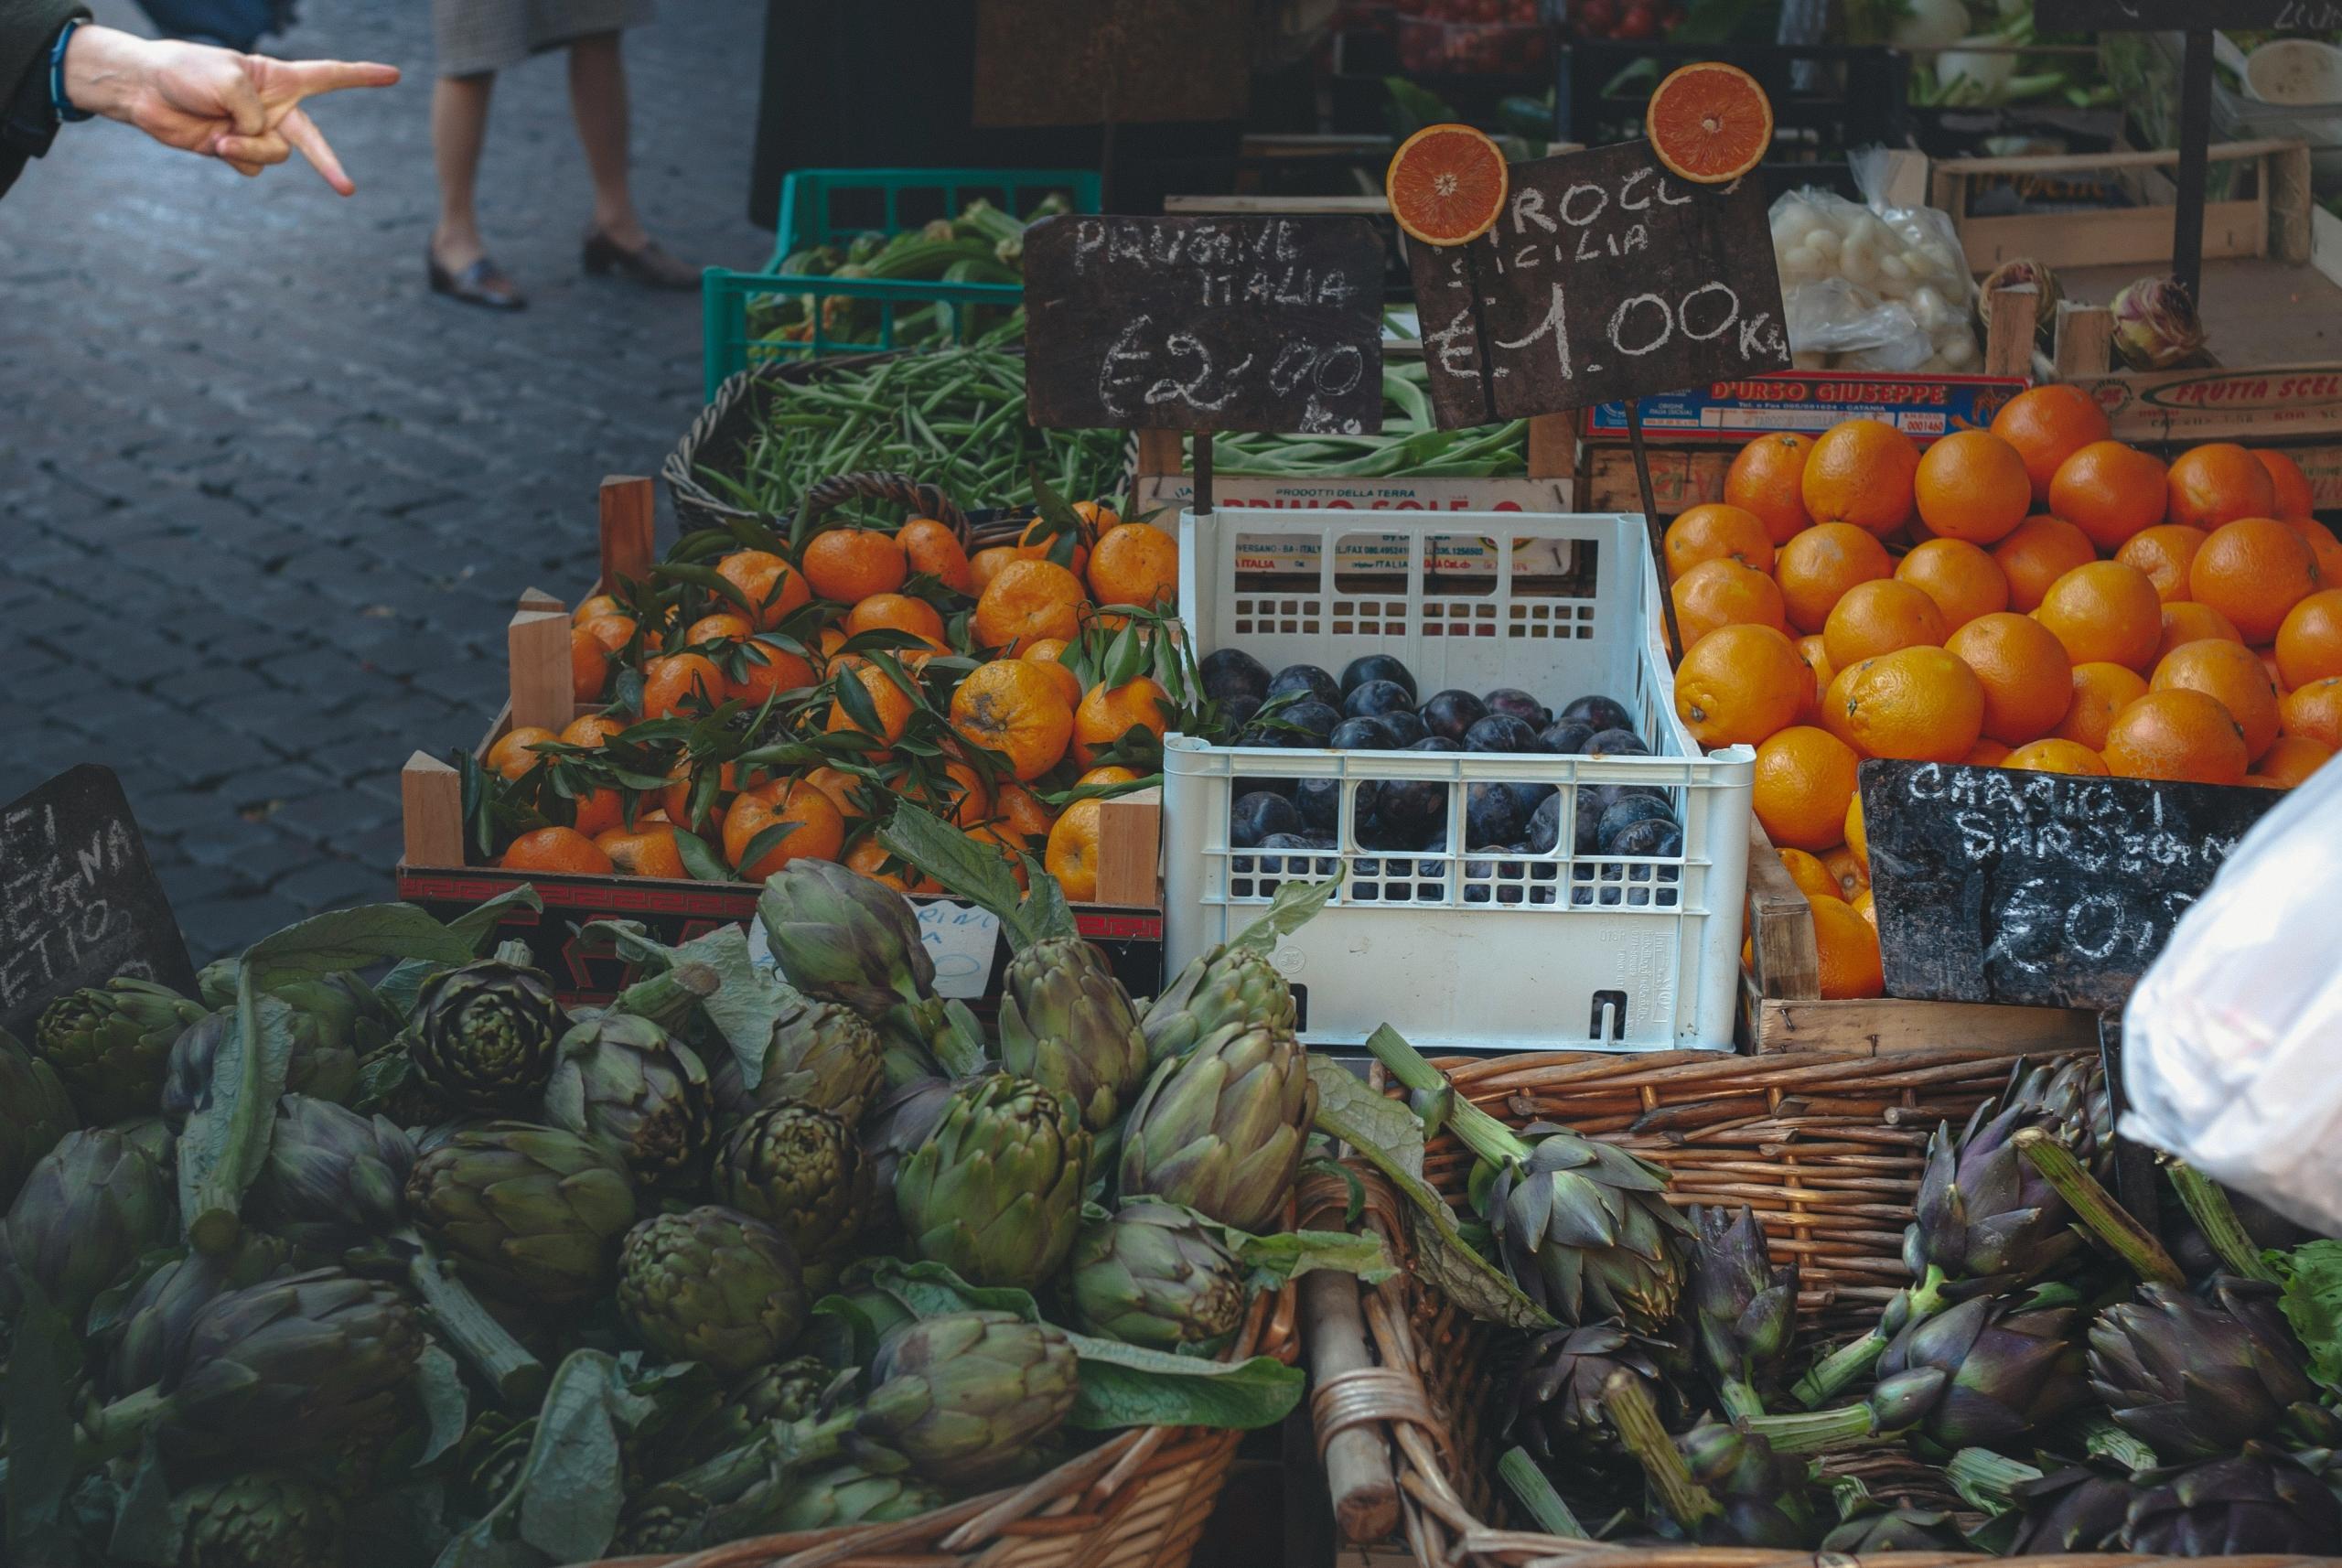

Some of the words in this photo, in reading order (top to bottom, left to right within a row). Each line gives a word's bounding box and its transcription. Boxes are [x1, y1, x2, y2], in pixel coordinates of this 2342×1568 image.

[1194, 266, 1358, 308] ITALIA
[1712, 381, 1808, 402] D'URSO
[1815, 382, 1947, 405] GIUSEPPE
[2175, 380, 2269, 403] FRUTTA
[1275, 489, 1335, 497] PRODOTTI
[1337, 489, 1373, 498] DELLA
[1377, 489, 1415, 498] TERRA
[1237, 544, 1276, 553] VERSANO
[1241, 559, 1274, 568] ITALIA
